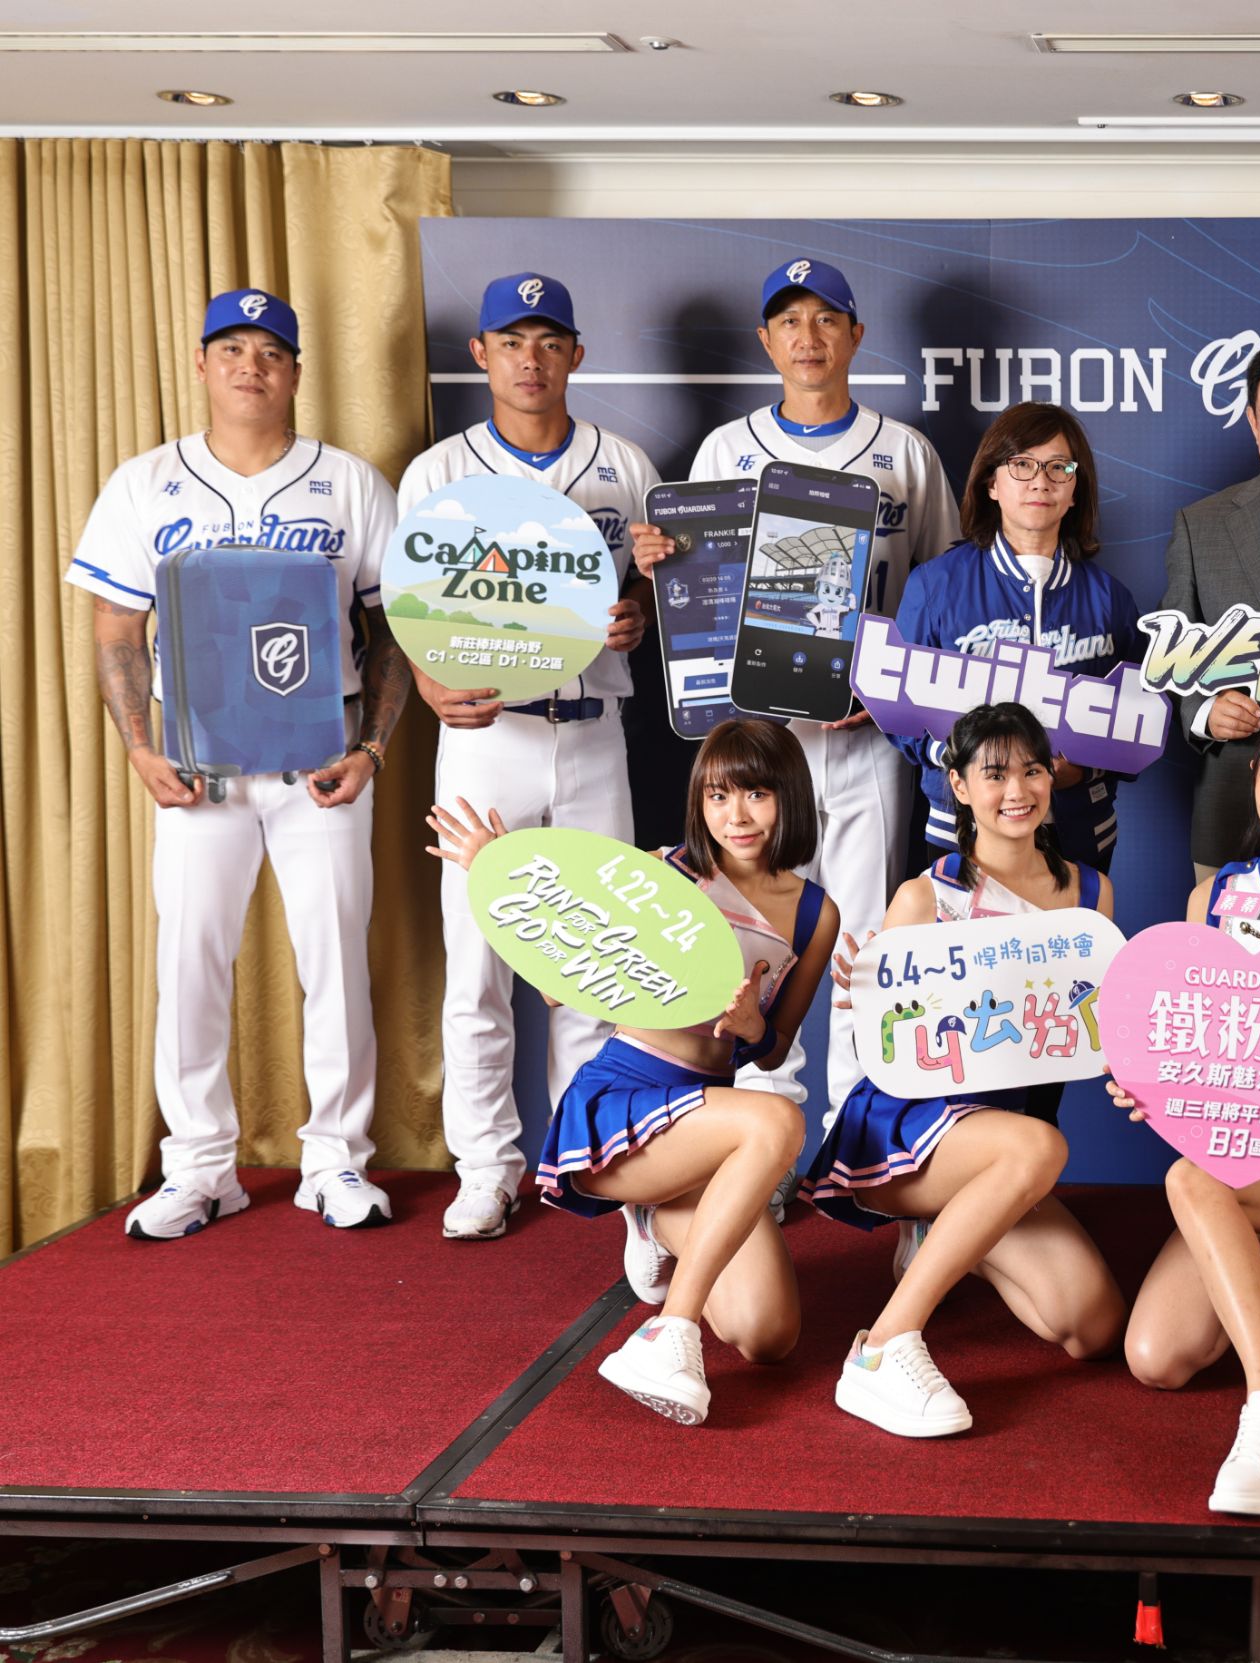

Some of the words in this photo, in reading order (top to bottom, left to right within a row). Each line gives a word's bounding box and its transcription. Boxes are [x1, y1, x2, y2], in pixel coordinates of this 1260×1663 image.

[921, 348, 1167, 412] FUBON
[404, 530, 602, 584] Camping
[704, 529, 736, 538] FRANKIE
[441, 567, 548, 604] Zone
[449, 636, 542, 654] 新莊棒球場內野
[854, 619, 1168, 748] twitch
[488, 893, 548, 942] GO
[535, 940, 567, 963] FOR
[560, 950, 636, 1010] WIN
[508, 854, 584, 915] RUN
[564, 912, 597, 934] FOR
[592, 925, 688, 1006] GREEN
[973, 932, 1094, 970] 悍將同樂會
